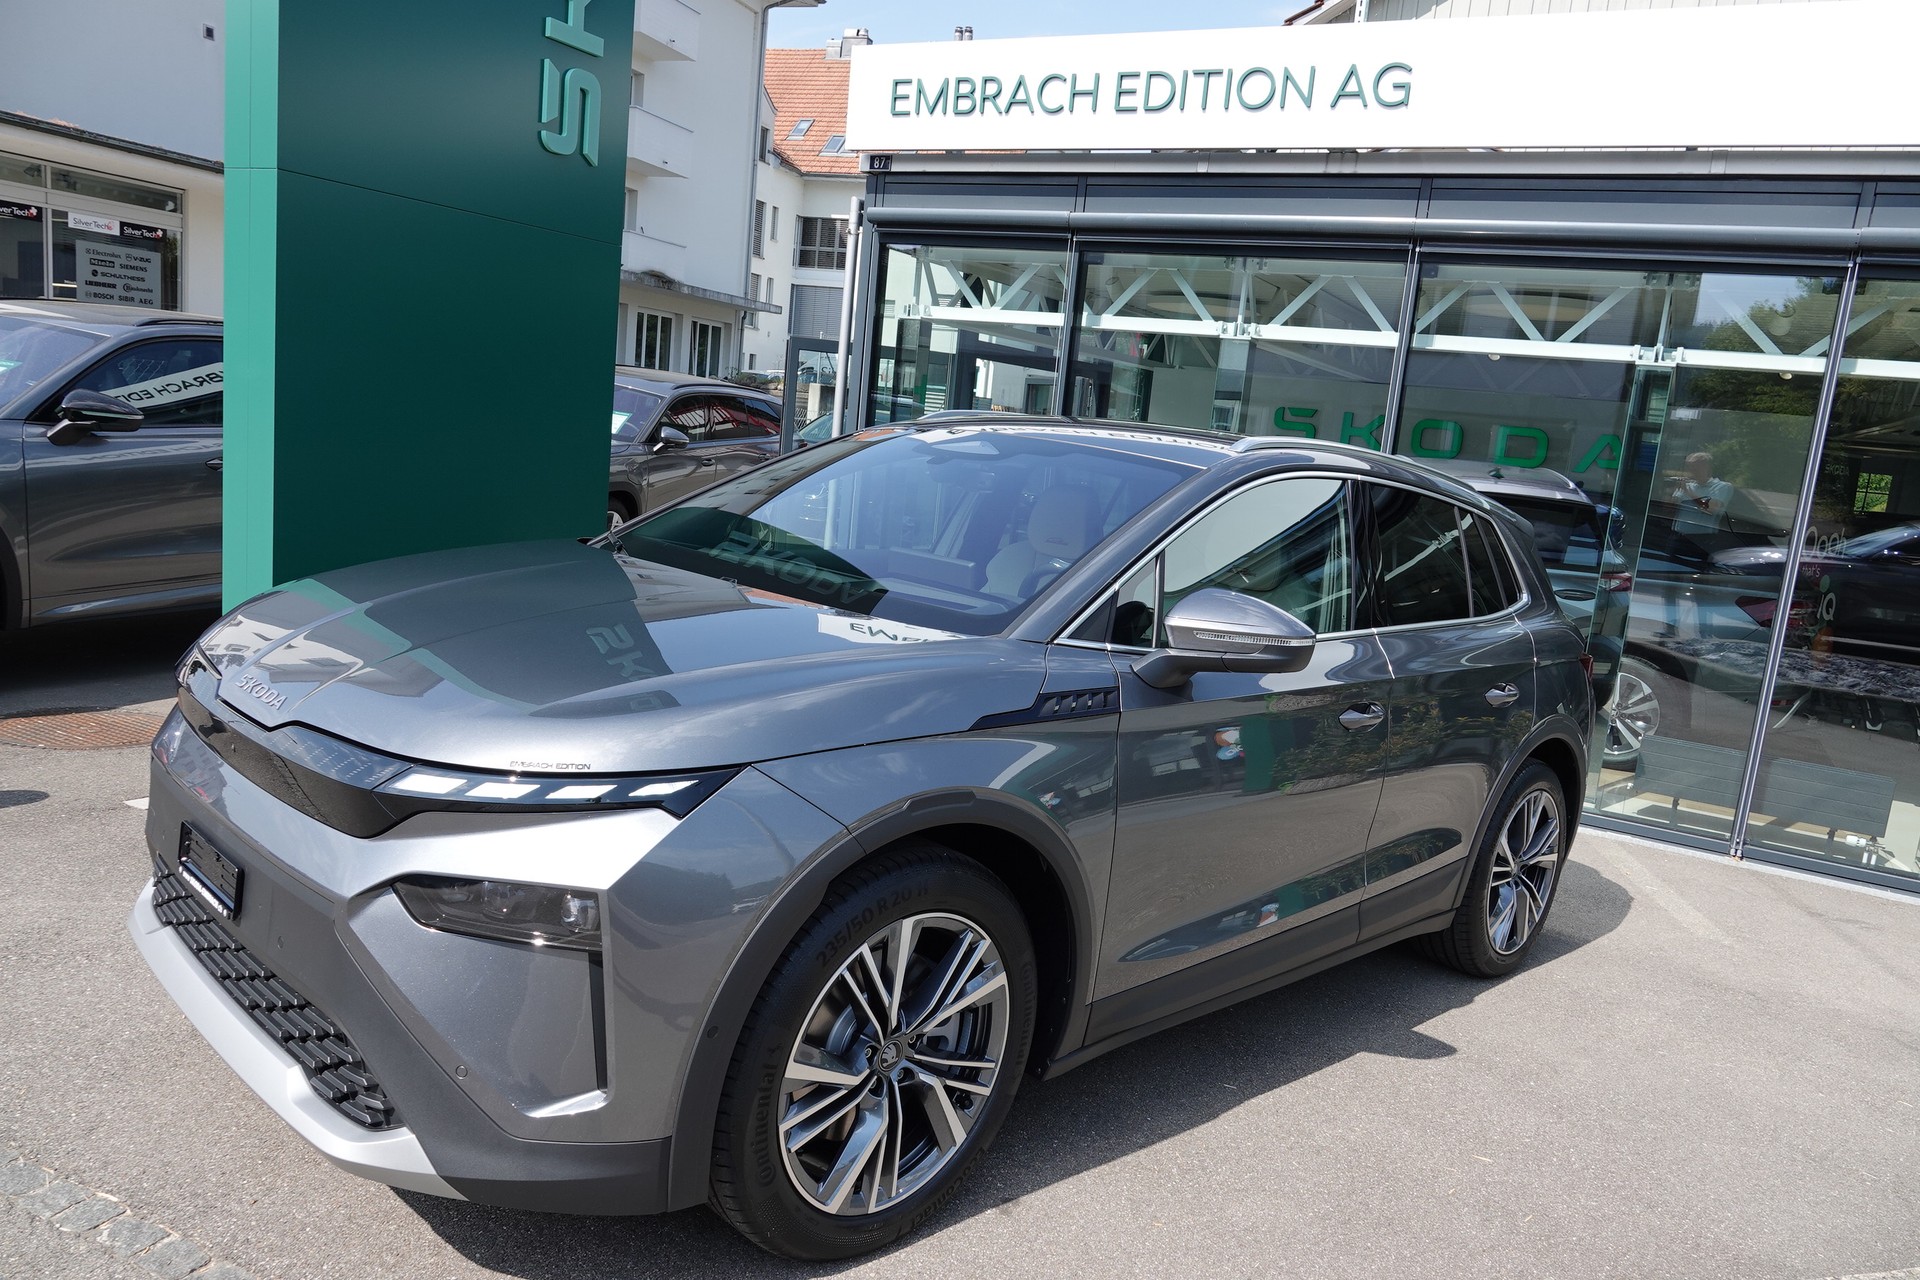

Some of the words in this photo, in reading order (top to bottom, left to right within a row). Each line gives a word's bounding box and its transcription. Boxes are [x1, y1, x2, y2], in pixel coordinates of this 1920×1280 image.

[891, 72, 1101, 116] EMBRACH
[1114, 65, 1316, 114] EDITION
[1330, 62, 1414, 109] AG
[873, 157, 885, 169] 87
[92, 248, 121, 259] Electrolux
[120, 263, 147, 272] SIEMENS
[93, 292, 114, 300] BOSCH
[816, 907, 874, 967] 235/50
[876, 897, 889, 916] R
[891, 884, 913, 908] 20
[751, 1062, 778, 1187] Continental
